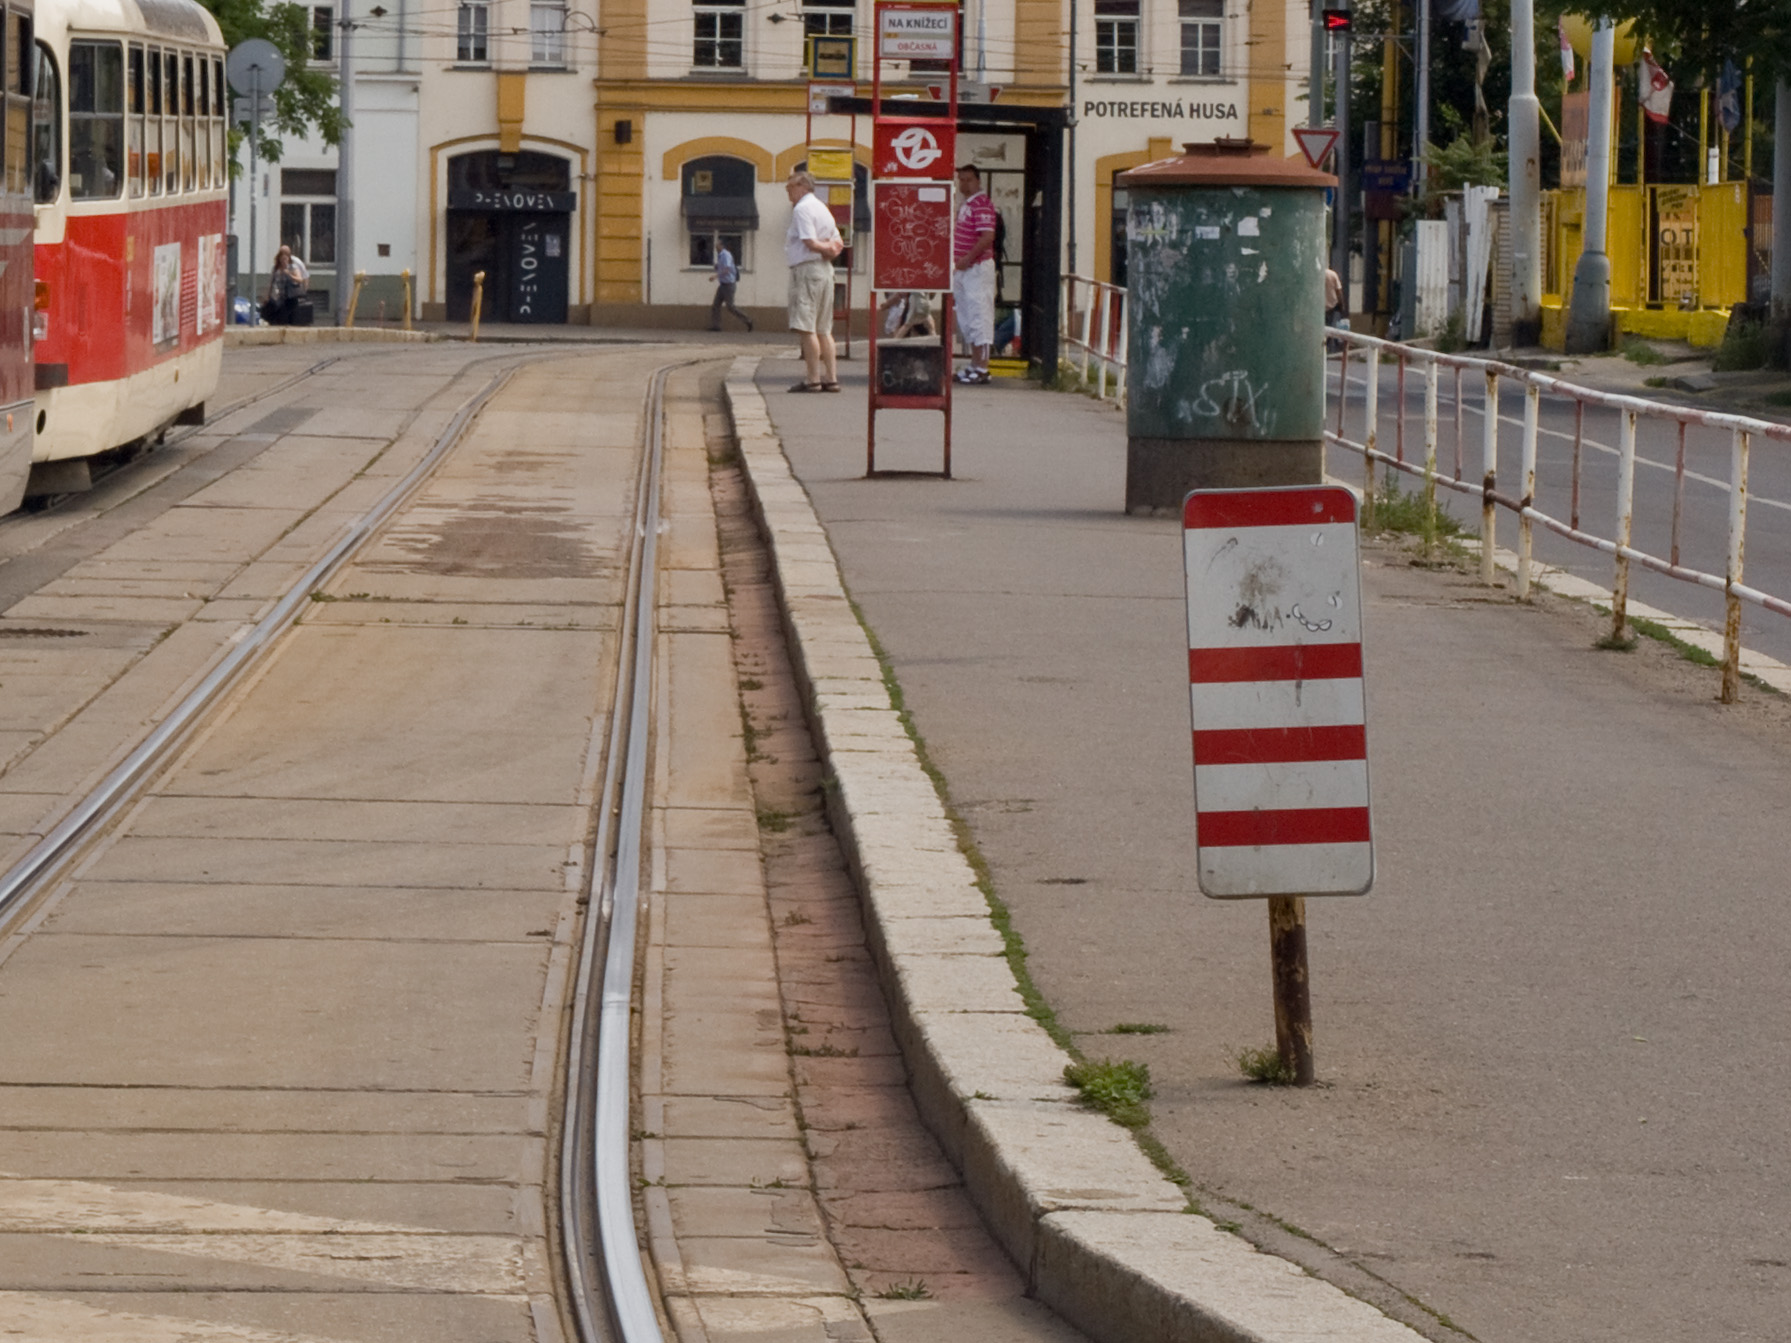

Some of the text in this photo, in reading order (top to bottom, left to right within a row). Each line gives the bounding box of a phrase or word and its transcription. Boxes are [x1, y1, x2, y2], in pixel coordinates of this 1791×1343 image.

[888, 17, 948, 29] NA KNÍŽECÍ
[897, 40, 937, 51] OBČASNÁ
[1084, 97, 1238, 120] POTREFENÁ HUSA
